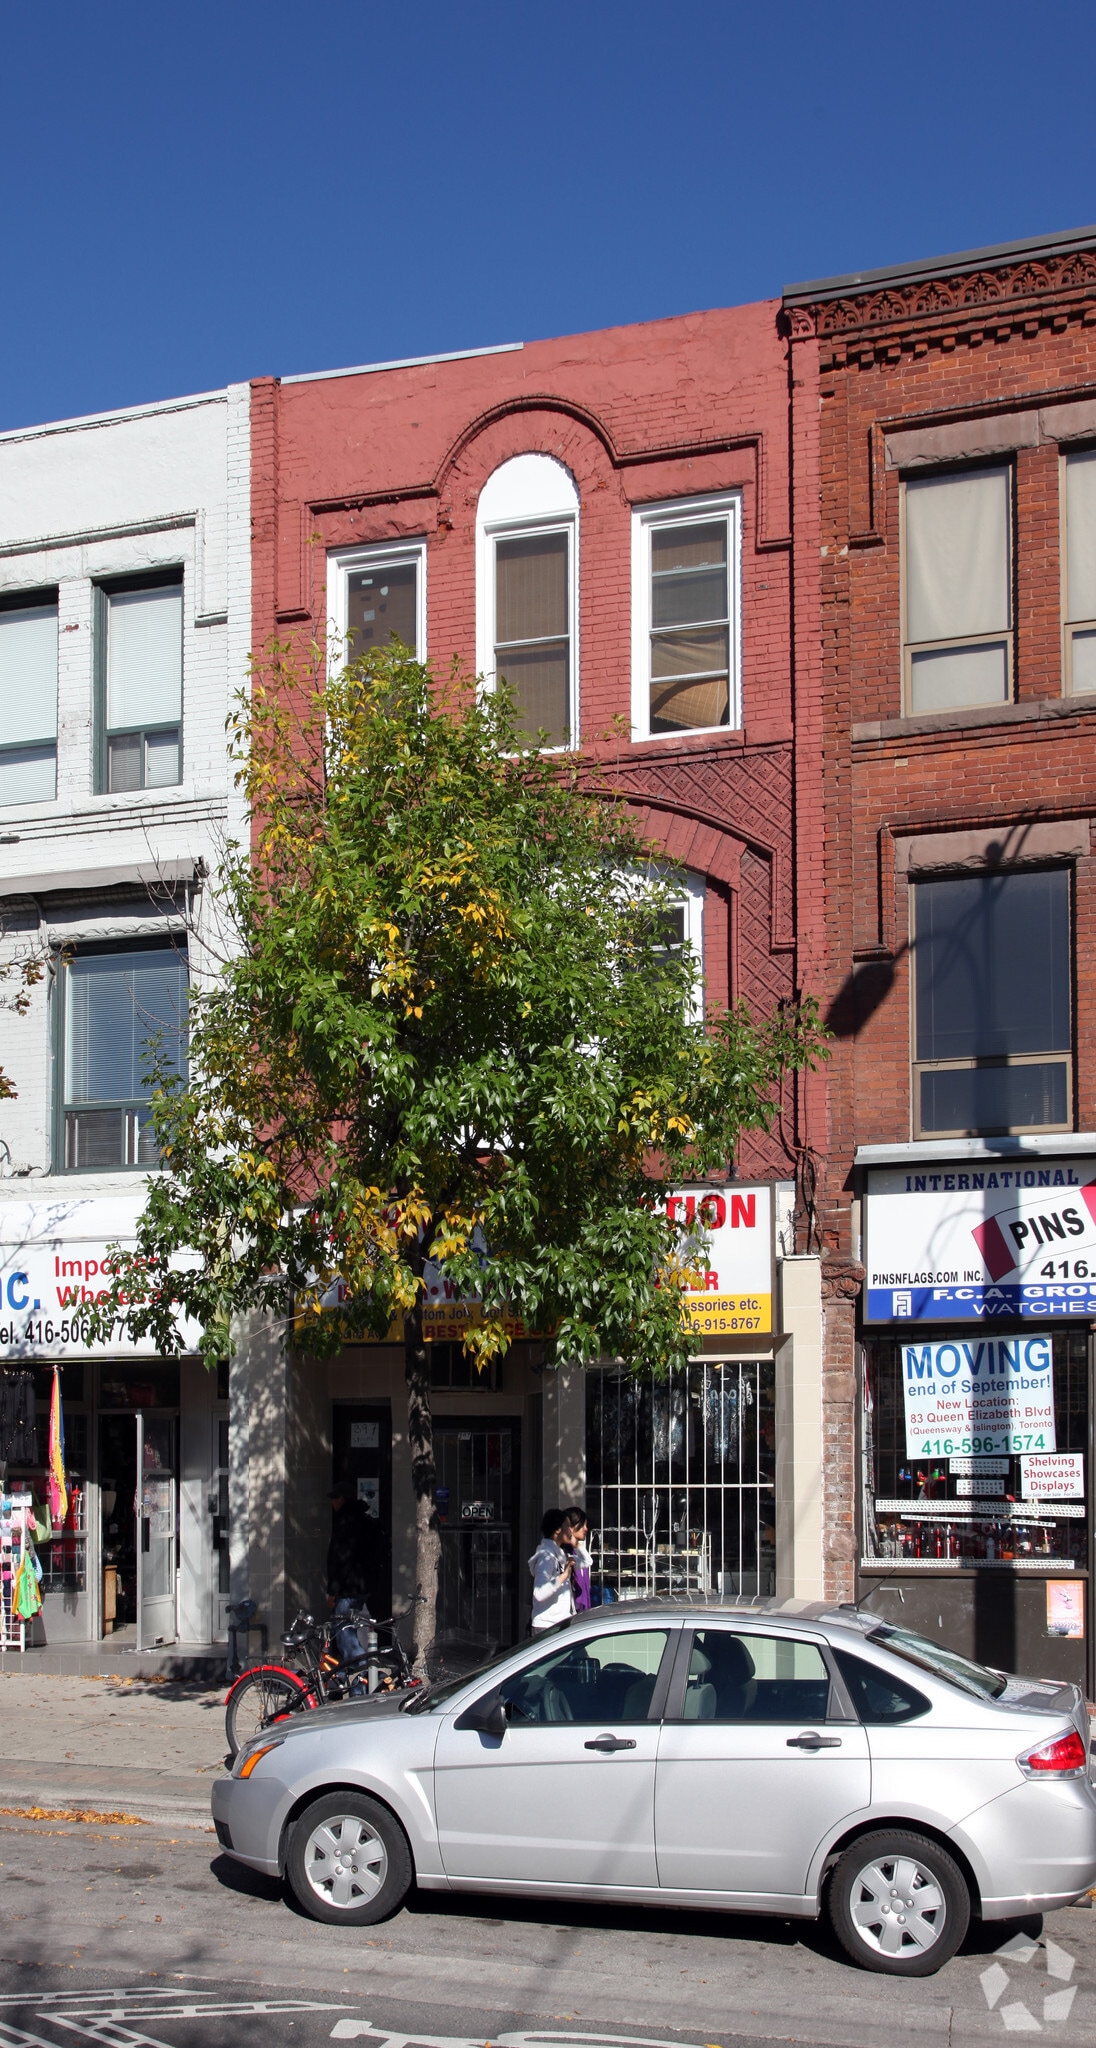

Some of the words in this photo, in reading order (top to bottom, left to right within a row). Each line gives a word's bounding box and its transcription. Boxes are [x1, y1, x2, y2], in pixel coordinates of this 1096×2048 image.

[906, 1169, 1079, 1192] INTERNATIONAL
[1008, 1207, 1085, 1250] PINS
[872, 1271, 959, 1286] PINSNFLAGS.COM
[963, 1270, 984, 1282] INC.
[0, 1271, 41, 1311] c.
[933, 1287, 1013, 1301] F.C.A.
[739, 1297, 762, 1311] etc.
[0, 1321, 19, 1345] el.
[24, 1319, 136, 1344] 416-5060775
[906, 1337, 1050, 1380] MOVING
[908, 1382, 937, 1396] end
[941, 1380, 957, 1394] of
[961, 1374, 1050, 1395] September!
[937, 1399, 961, 1410] New
[965, 1396, 1019, 1409] Location:
[910, 1413, 924, 1424] 83
[927, 1411, 964, 1423] Queen
[968, 1408, 1021, 1421] Elizabeth
[1025, 1405, 1051, 1417] Blvd
[910, 1425, 962, 1437] (Queensway
[965, 1424, 971, 1432] &
[1019, 1420, 1053, 1430] Toronto
[921, 1434, 1046, 1456] 416-596-1574
[1028, 1456, 1075, 1468] Shelving
[1024, 1469, 1081, 1479] Showcases
[1030, 1480, 1075, 1492] Displays
[462, 1507, 494, 1517] OPEN
